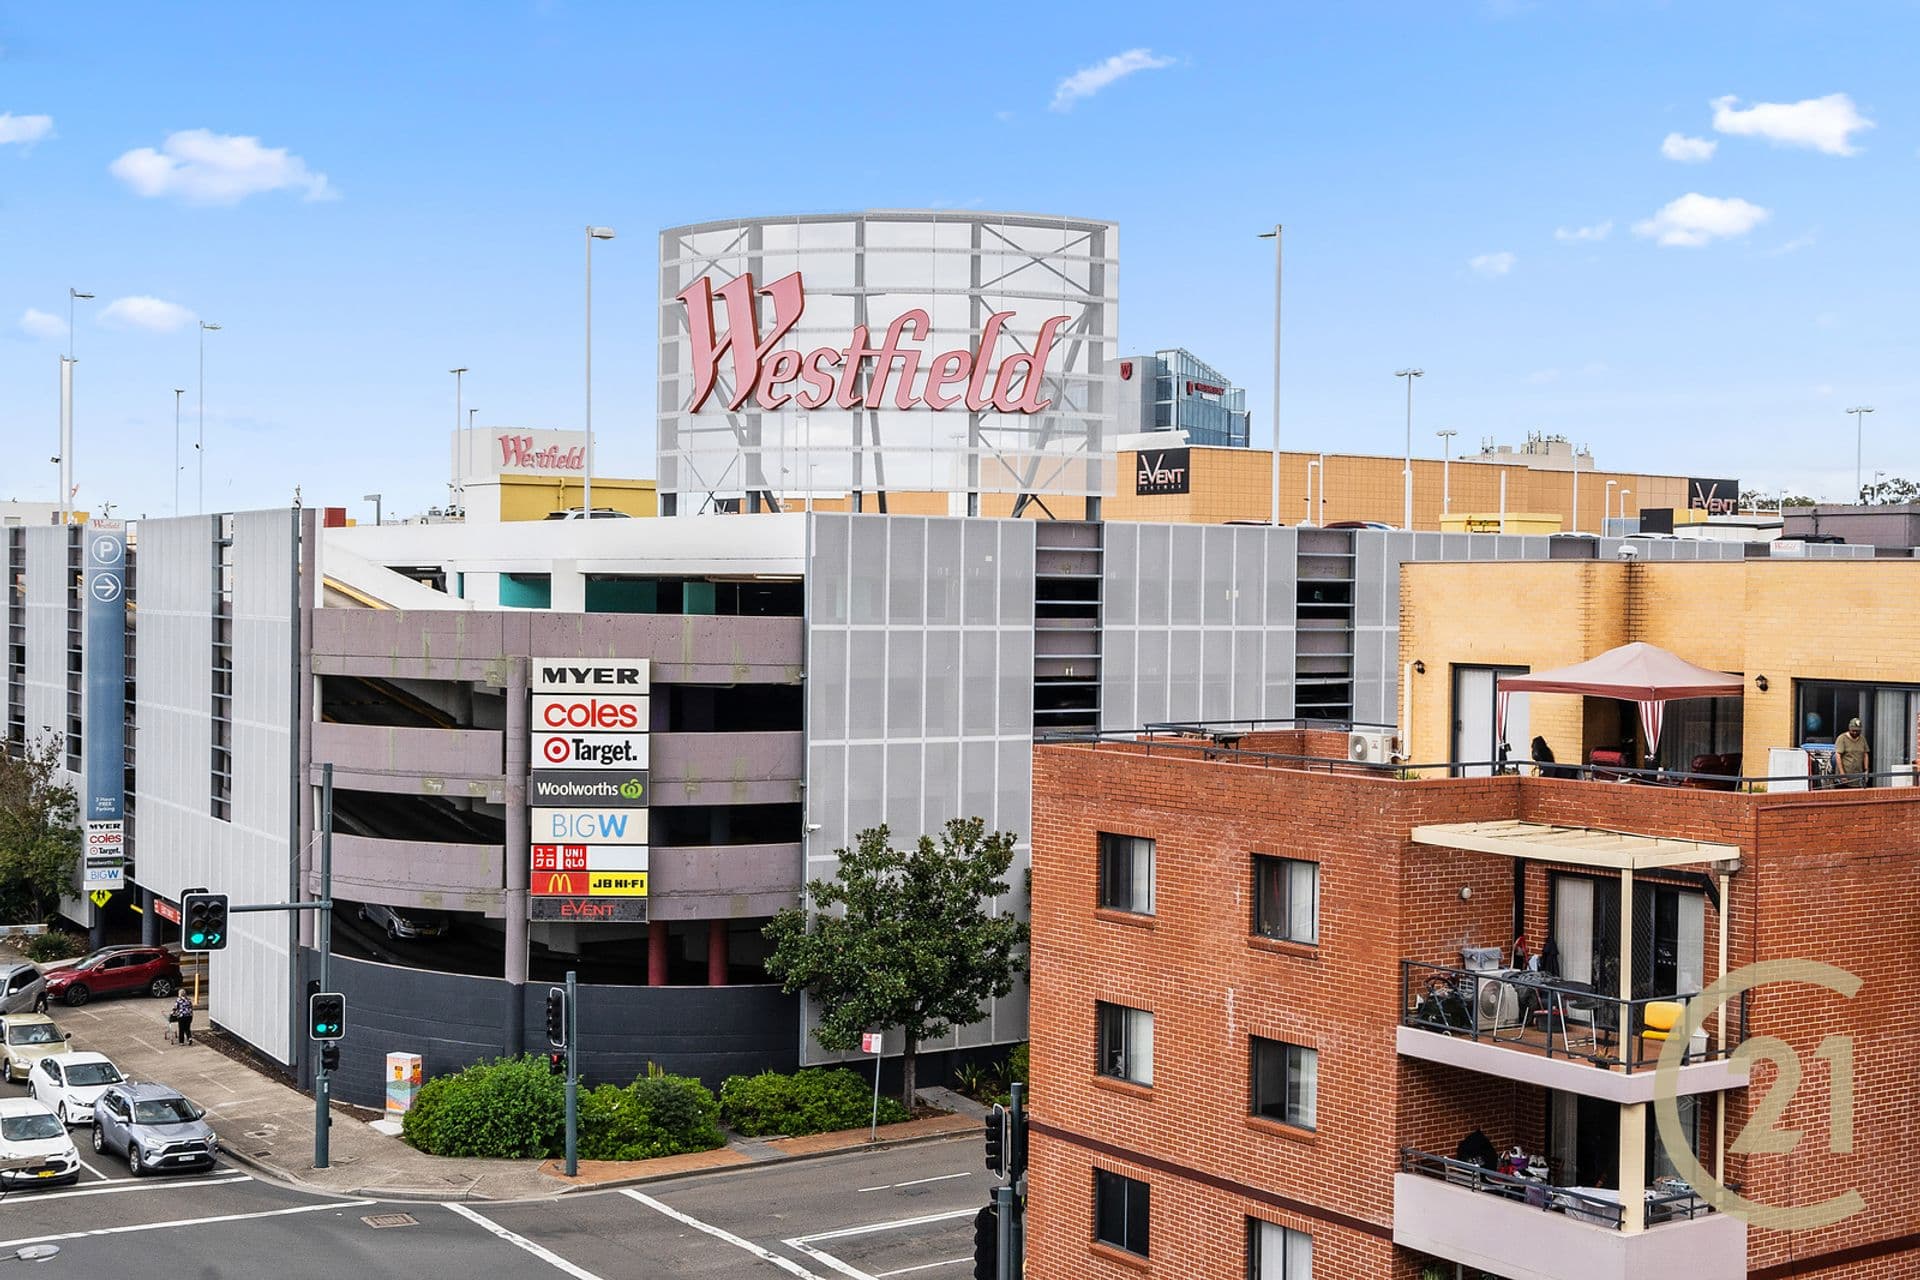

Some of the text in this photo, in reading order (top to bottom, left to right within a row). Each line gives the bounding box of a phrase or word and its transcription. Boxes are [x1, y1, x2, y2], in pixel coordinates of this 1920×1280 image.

[676, 271, 1071, 415] Westfield
[498, 434, 586, 470] Westfield
[1139, 453, 1184, 484] EVENT
[1692, 482, 1736, 512] EVENT
[99, 541, 113, 558] P
[542, 667, 640, 684] MYER
[544, 699, 638, 728] coles
[537, 782, 619, 796] Woolworths
[90, 833, 122, 844] coles
[565, 848, 583, 857] UNI
[565, 858, 584, 868] QLO
[593, 879, 612, 888] JB
[561, 898, 615, 916] EVENT
